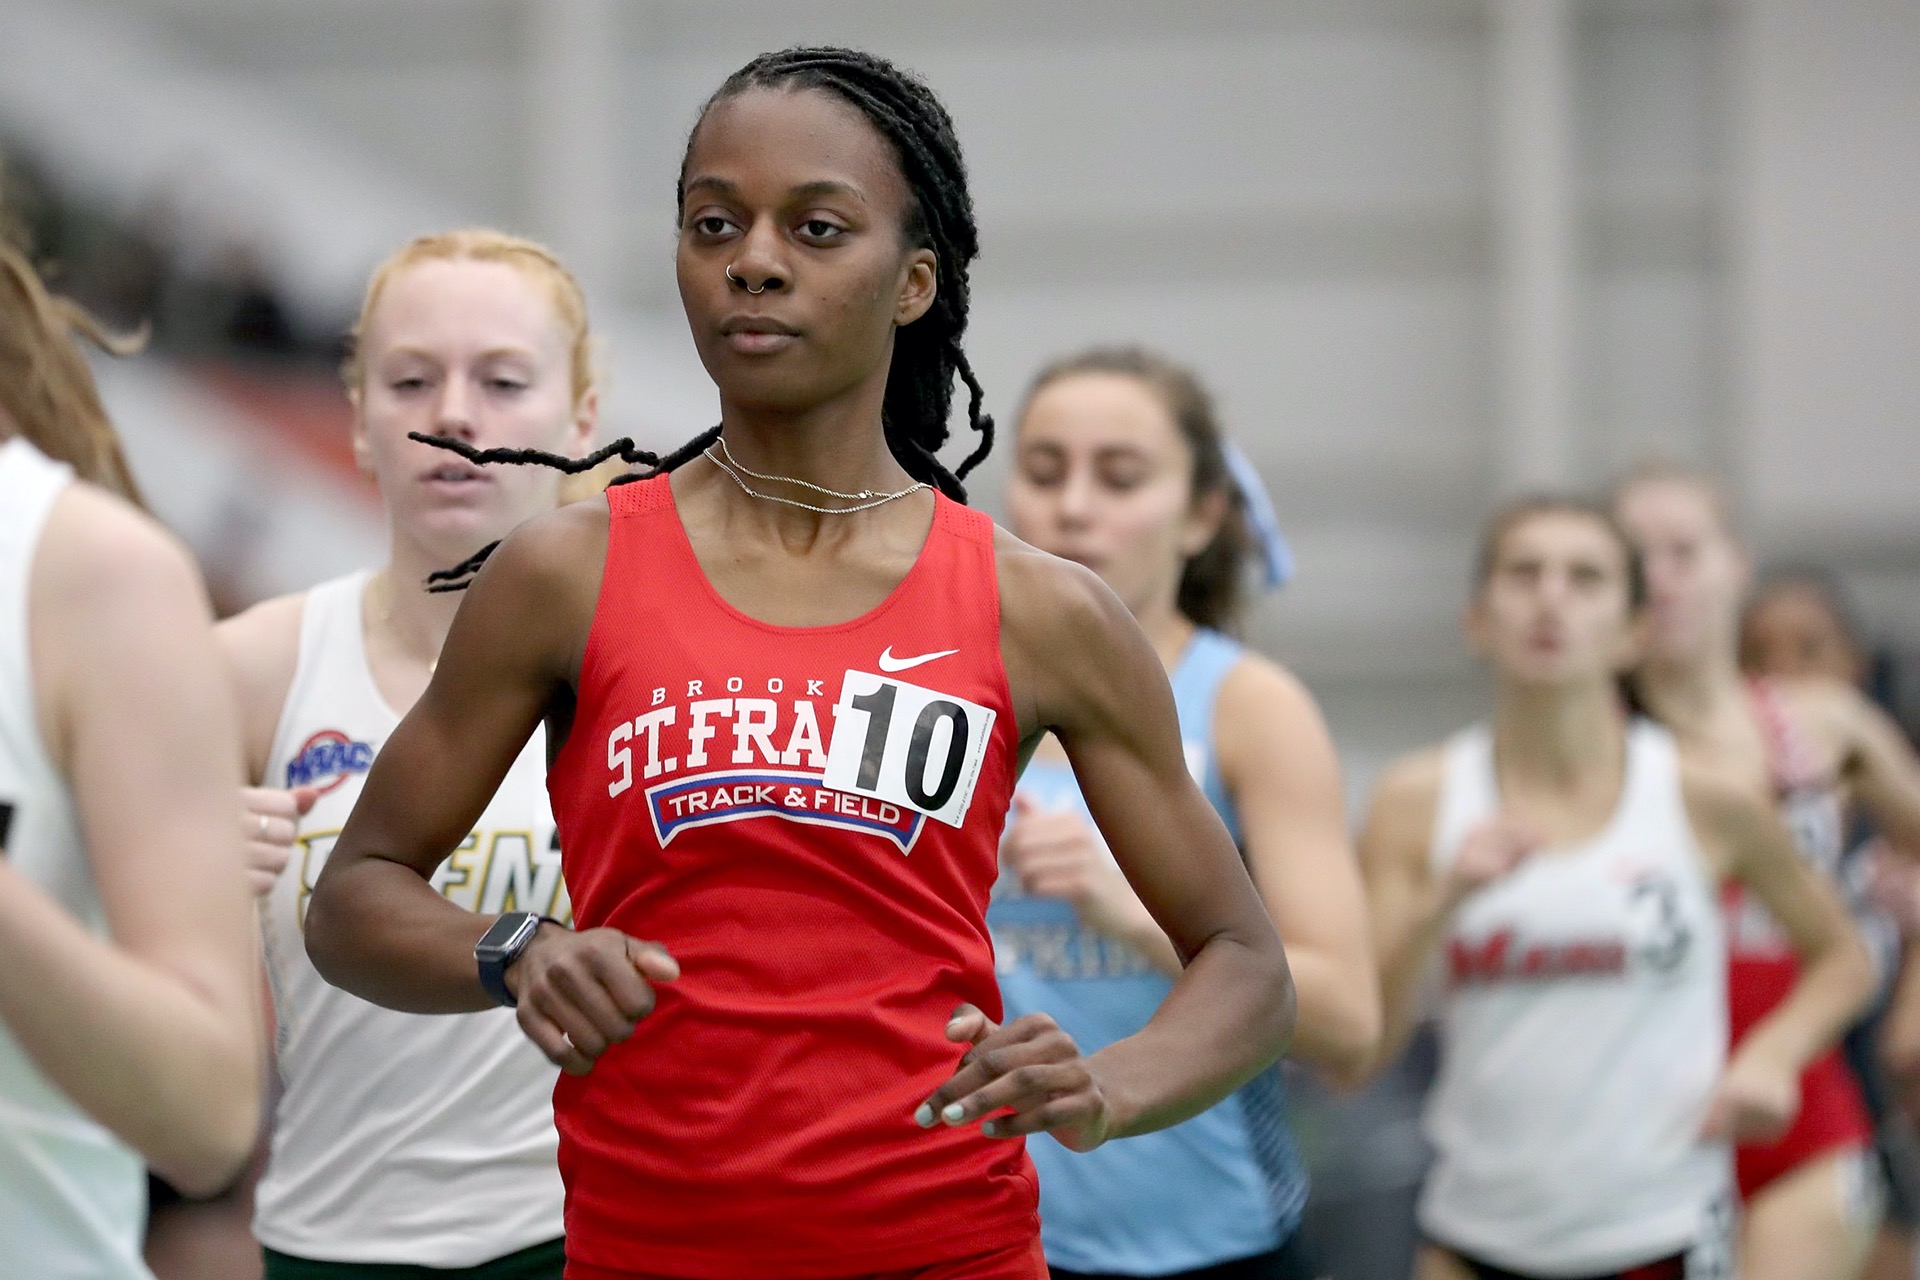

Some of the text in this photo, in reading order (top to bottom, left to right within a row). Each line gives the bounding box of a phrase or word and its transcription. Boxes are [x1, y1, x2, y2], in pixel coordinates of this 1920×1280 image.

[851, 683, 969, 812] 10
[669, 786, 900, 825] TRACK & FIELD
